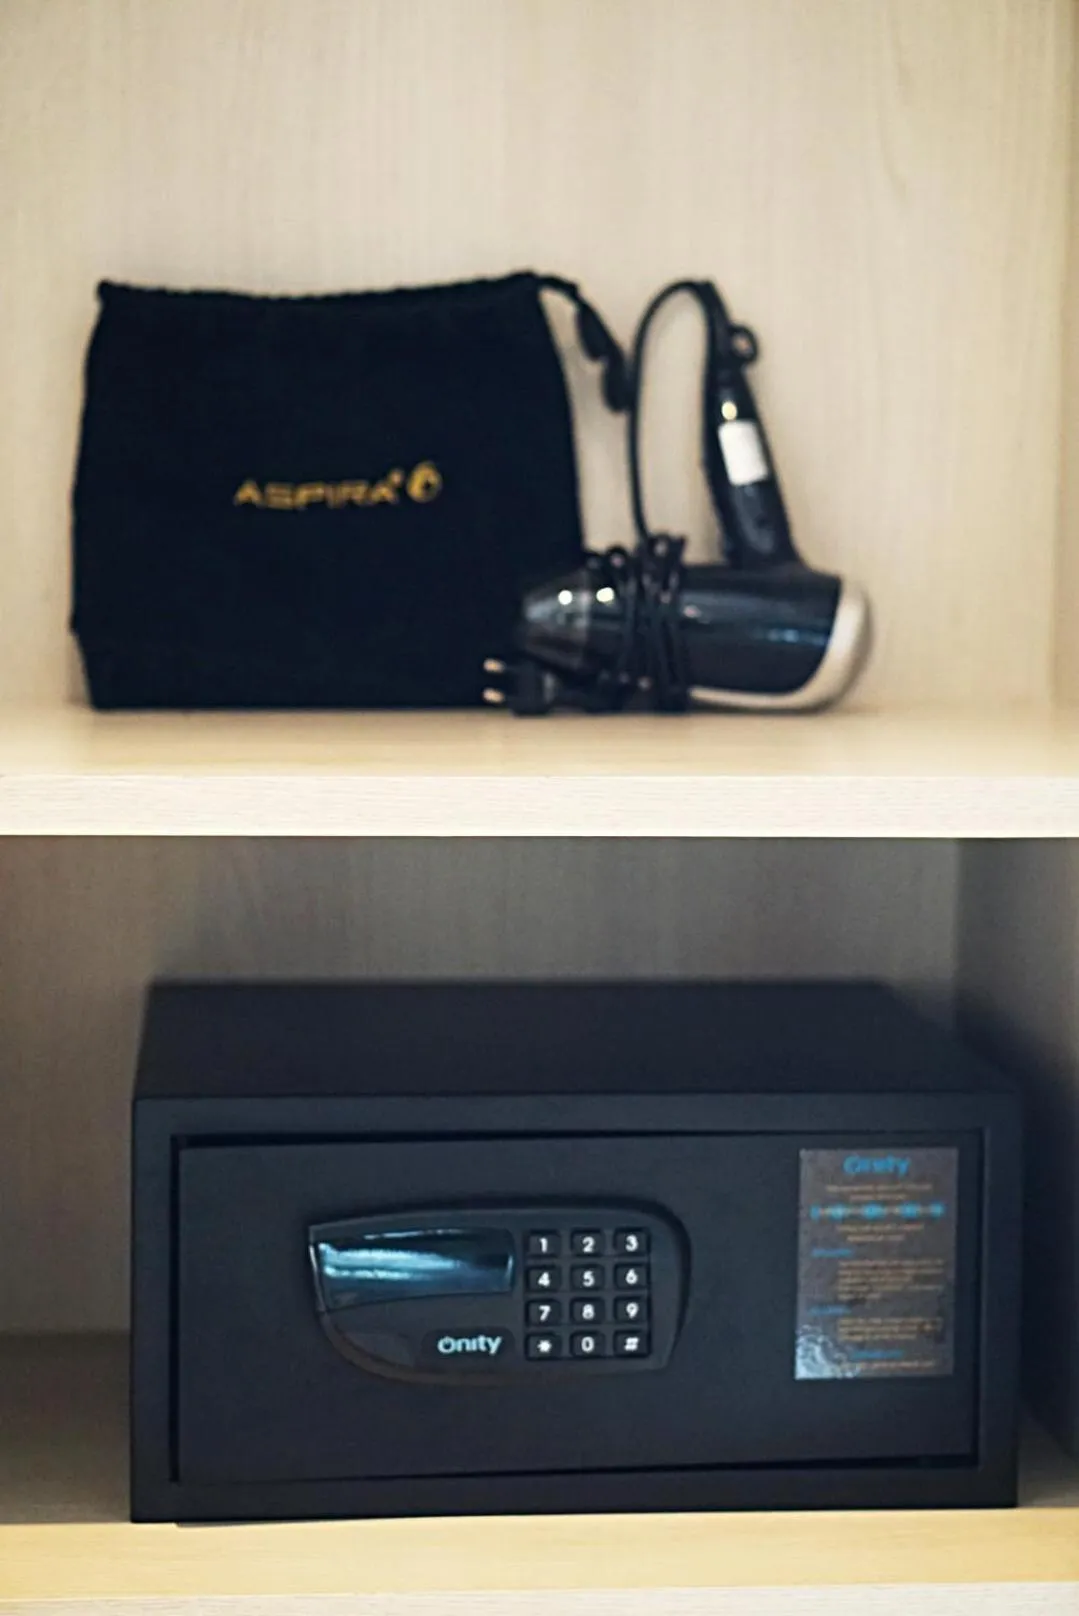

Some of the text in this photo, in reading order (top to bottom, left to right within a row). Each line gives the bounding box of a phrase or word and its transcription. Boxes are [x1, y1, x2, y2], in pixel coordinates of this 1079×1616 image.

[539, 1234, 639, 1253] 1 2 3
[537, 1268, 639, 1288] 4 5 6
[538, 1302, 639, 1321] 7 8 9
[437, 1334, 502, 1355] Onity
[623, 1336, 640, 1352] #
